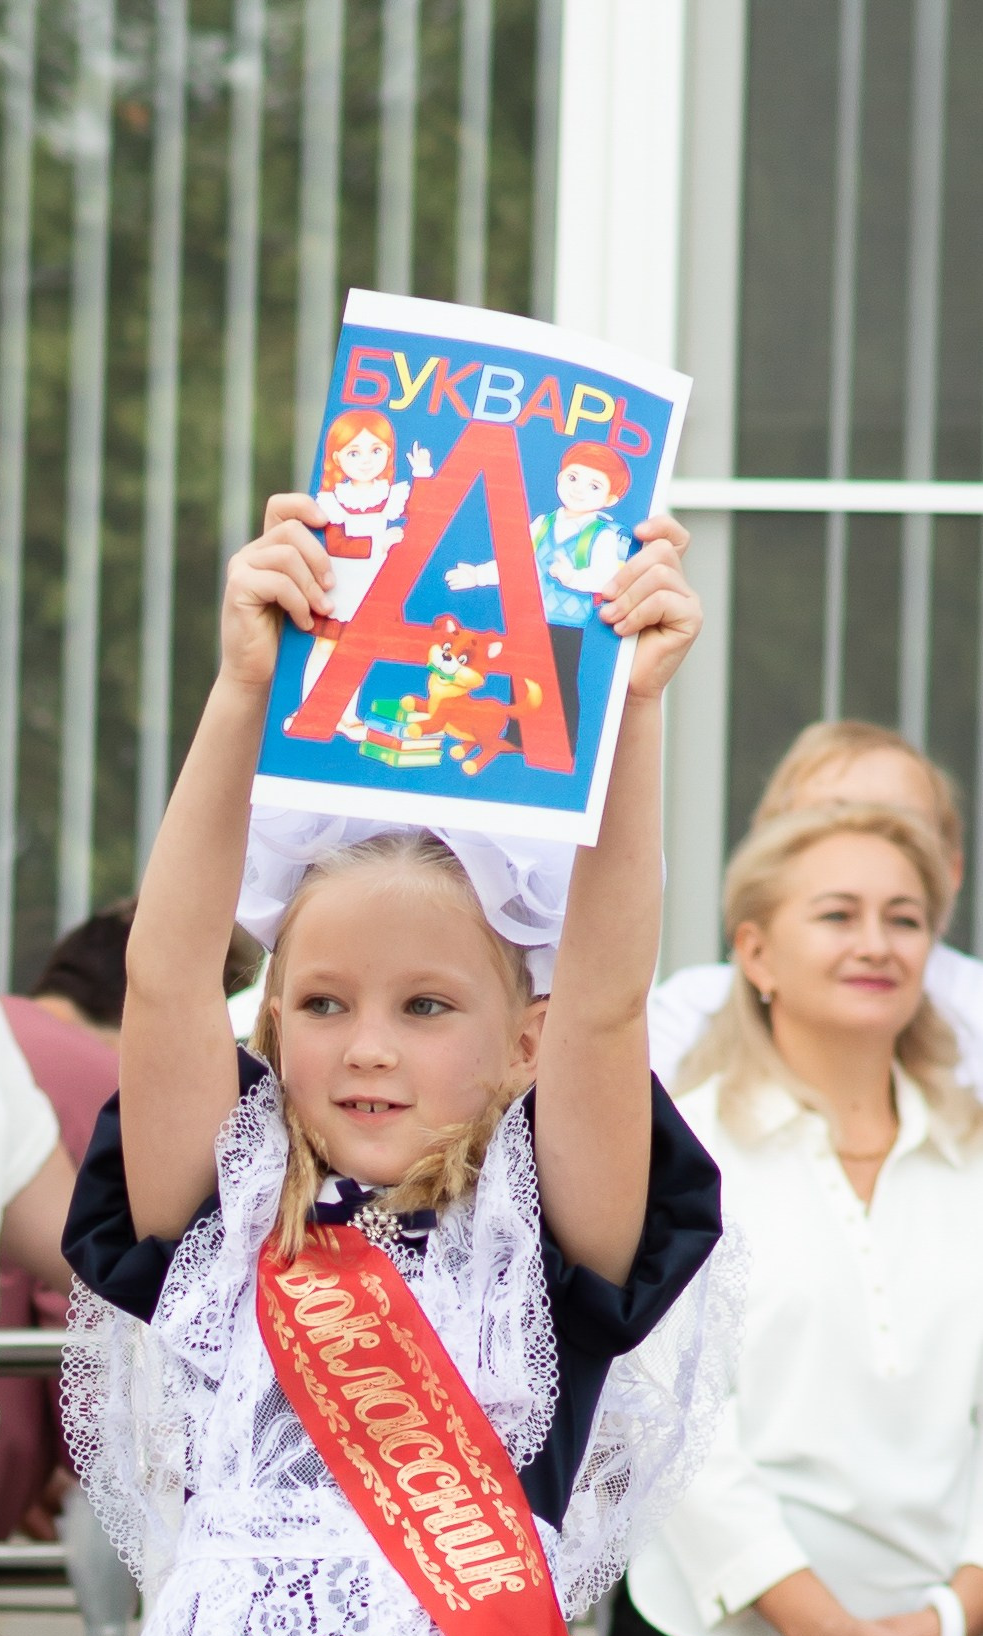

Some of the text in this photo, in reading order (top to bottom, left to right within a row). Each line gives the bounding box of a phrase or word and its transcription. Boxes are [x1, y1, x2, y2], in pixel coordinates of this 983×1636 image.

[340, 346, 652, 457] БУКВАРЬ
[284, 421, 575, 774] А
[274, 1260, 527, 1602] воклассник
